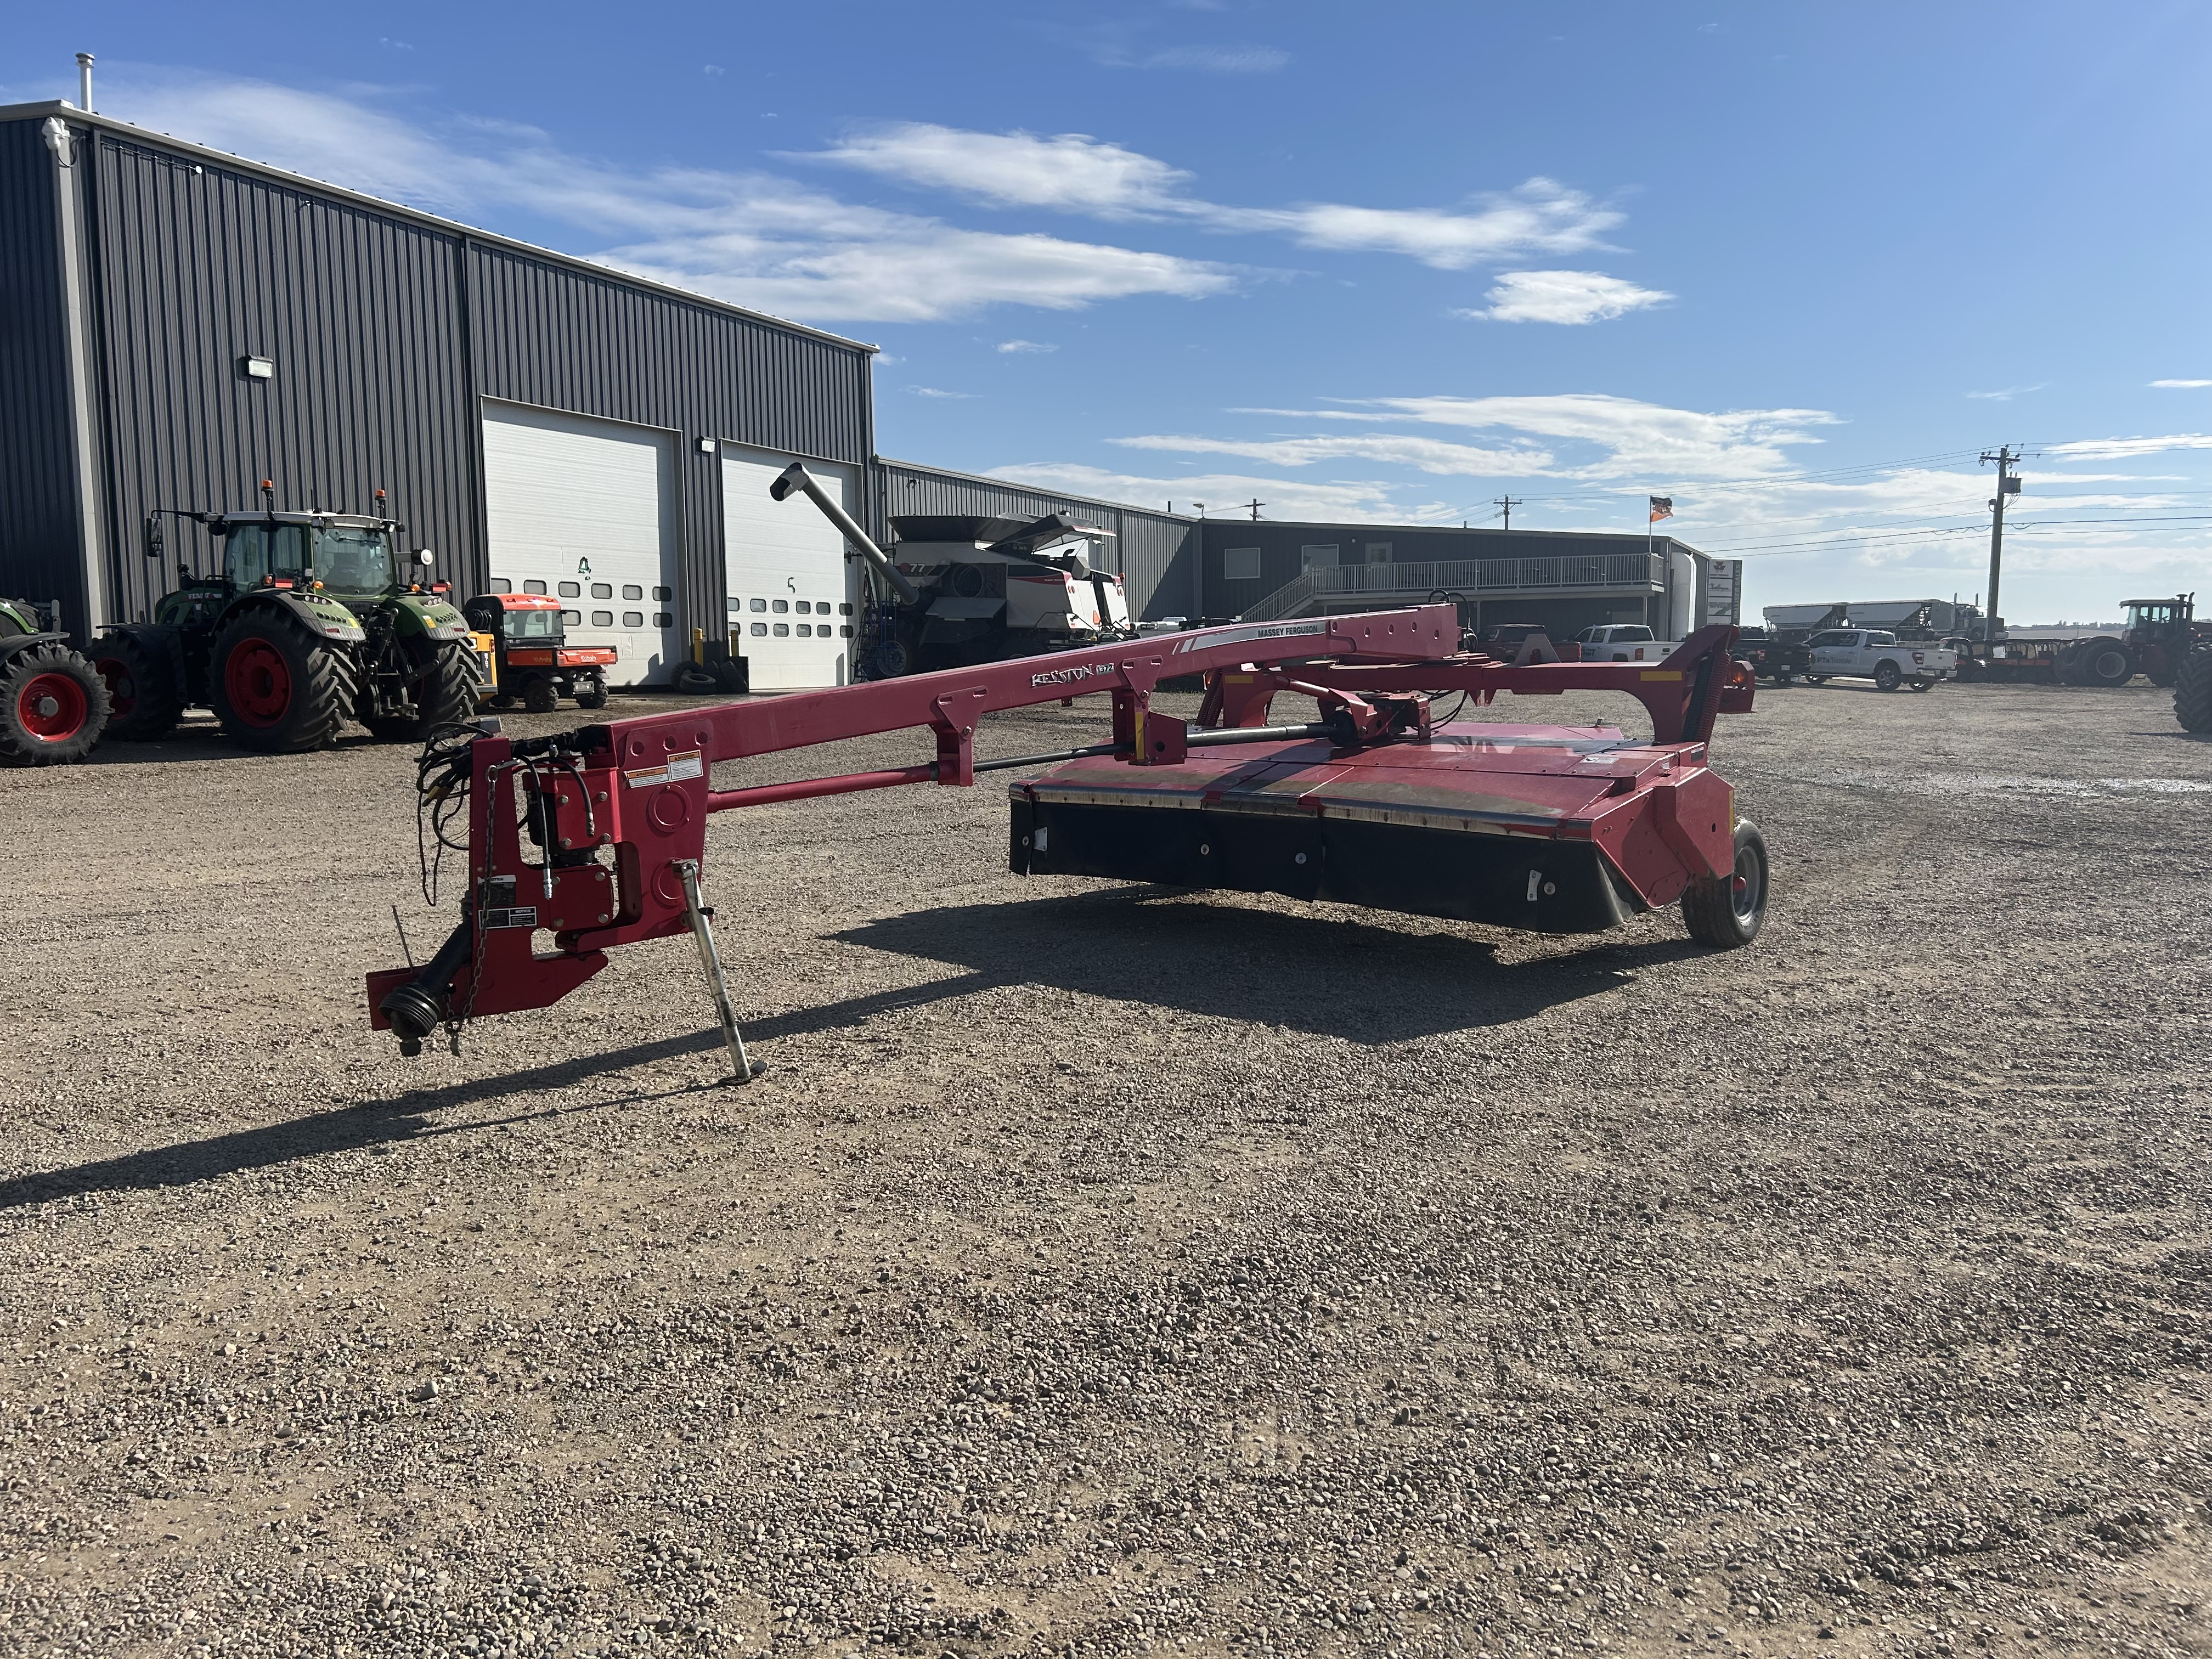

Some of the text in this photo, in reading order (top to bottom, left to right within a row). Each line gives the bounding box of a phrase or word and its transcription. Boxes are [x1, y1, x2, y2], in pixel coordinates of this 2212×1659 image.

[1258, 625, 1317, 638] MASSEY FERGUSON
[1097, 665, 1113, 674] 1372
